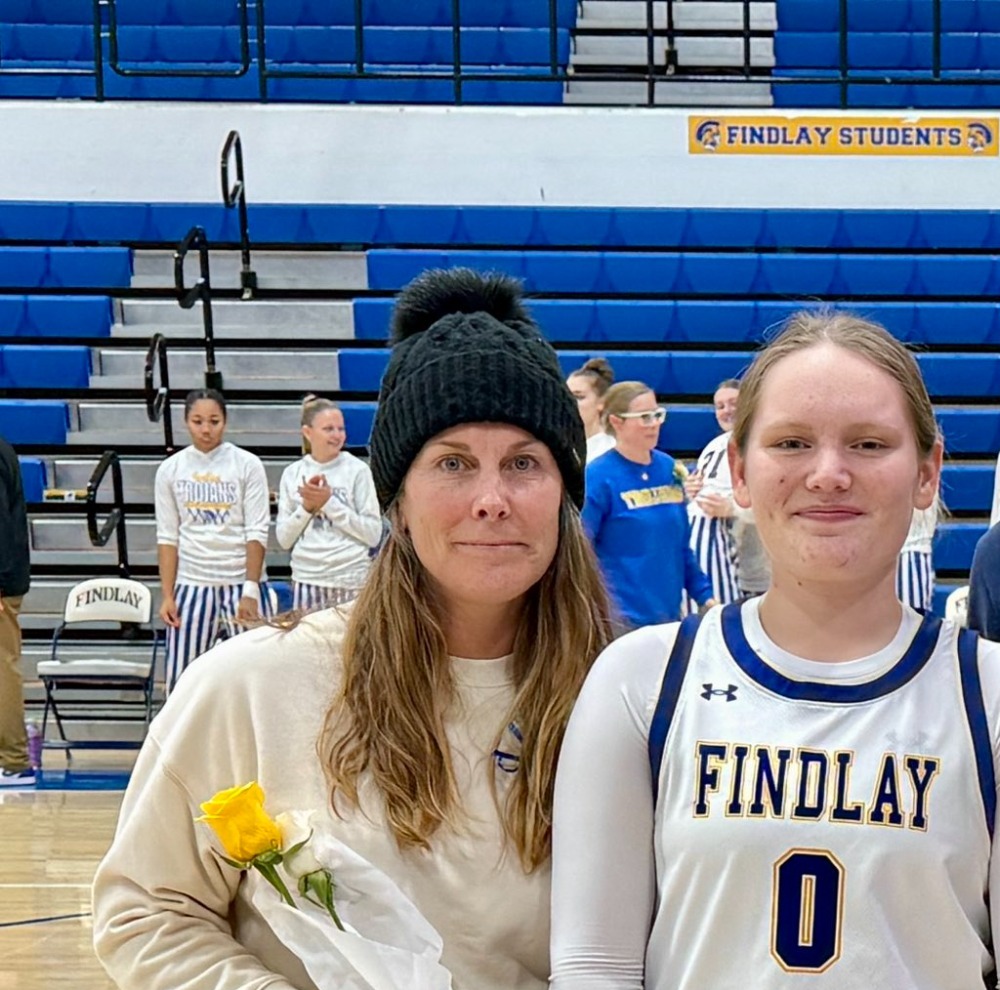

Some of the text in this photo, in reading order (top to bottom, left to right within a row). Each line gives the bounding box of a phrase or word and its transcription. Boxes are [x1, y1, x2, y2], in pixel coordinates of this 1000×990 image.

[726, 126, 962, 146] FINDLAY STUDENTS
[75, 586, 143, 609] FINDLAY
[693, 741, 941, 832] FINDLAY
[769, 847, 846, 974] 0
